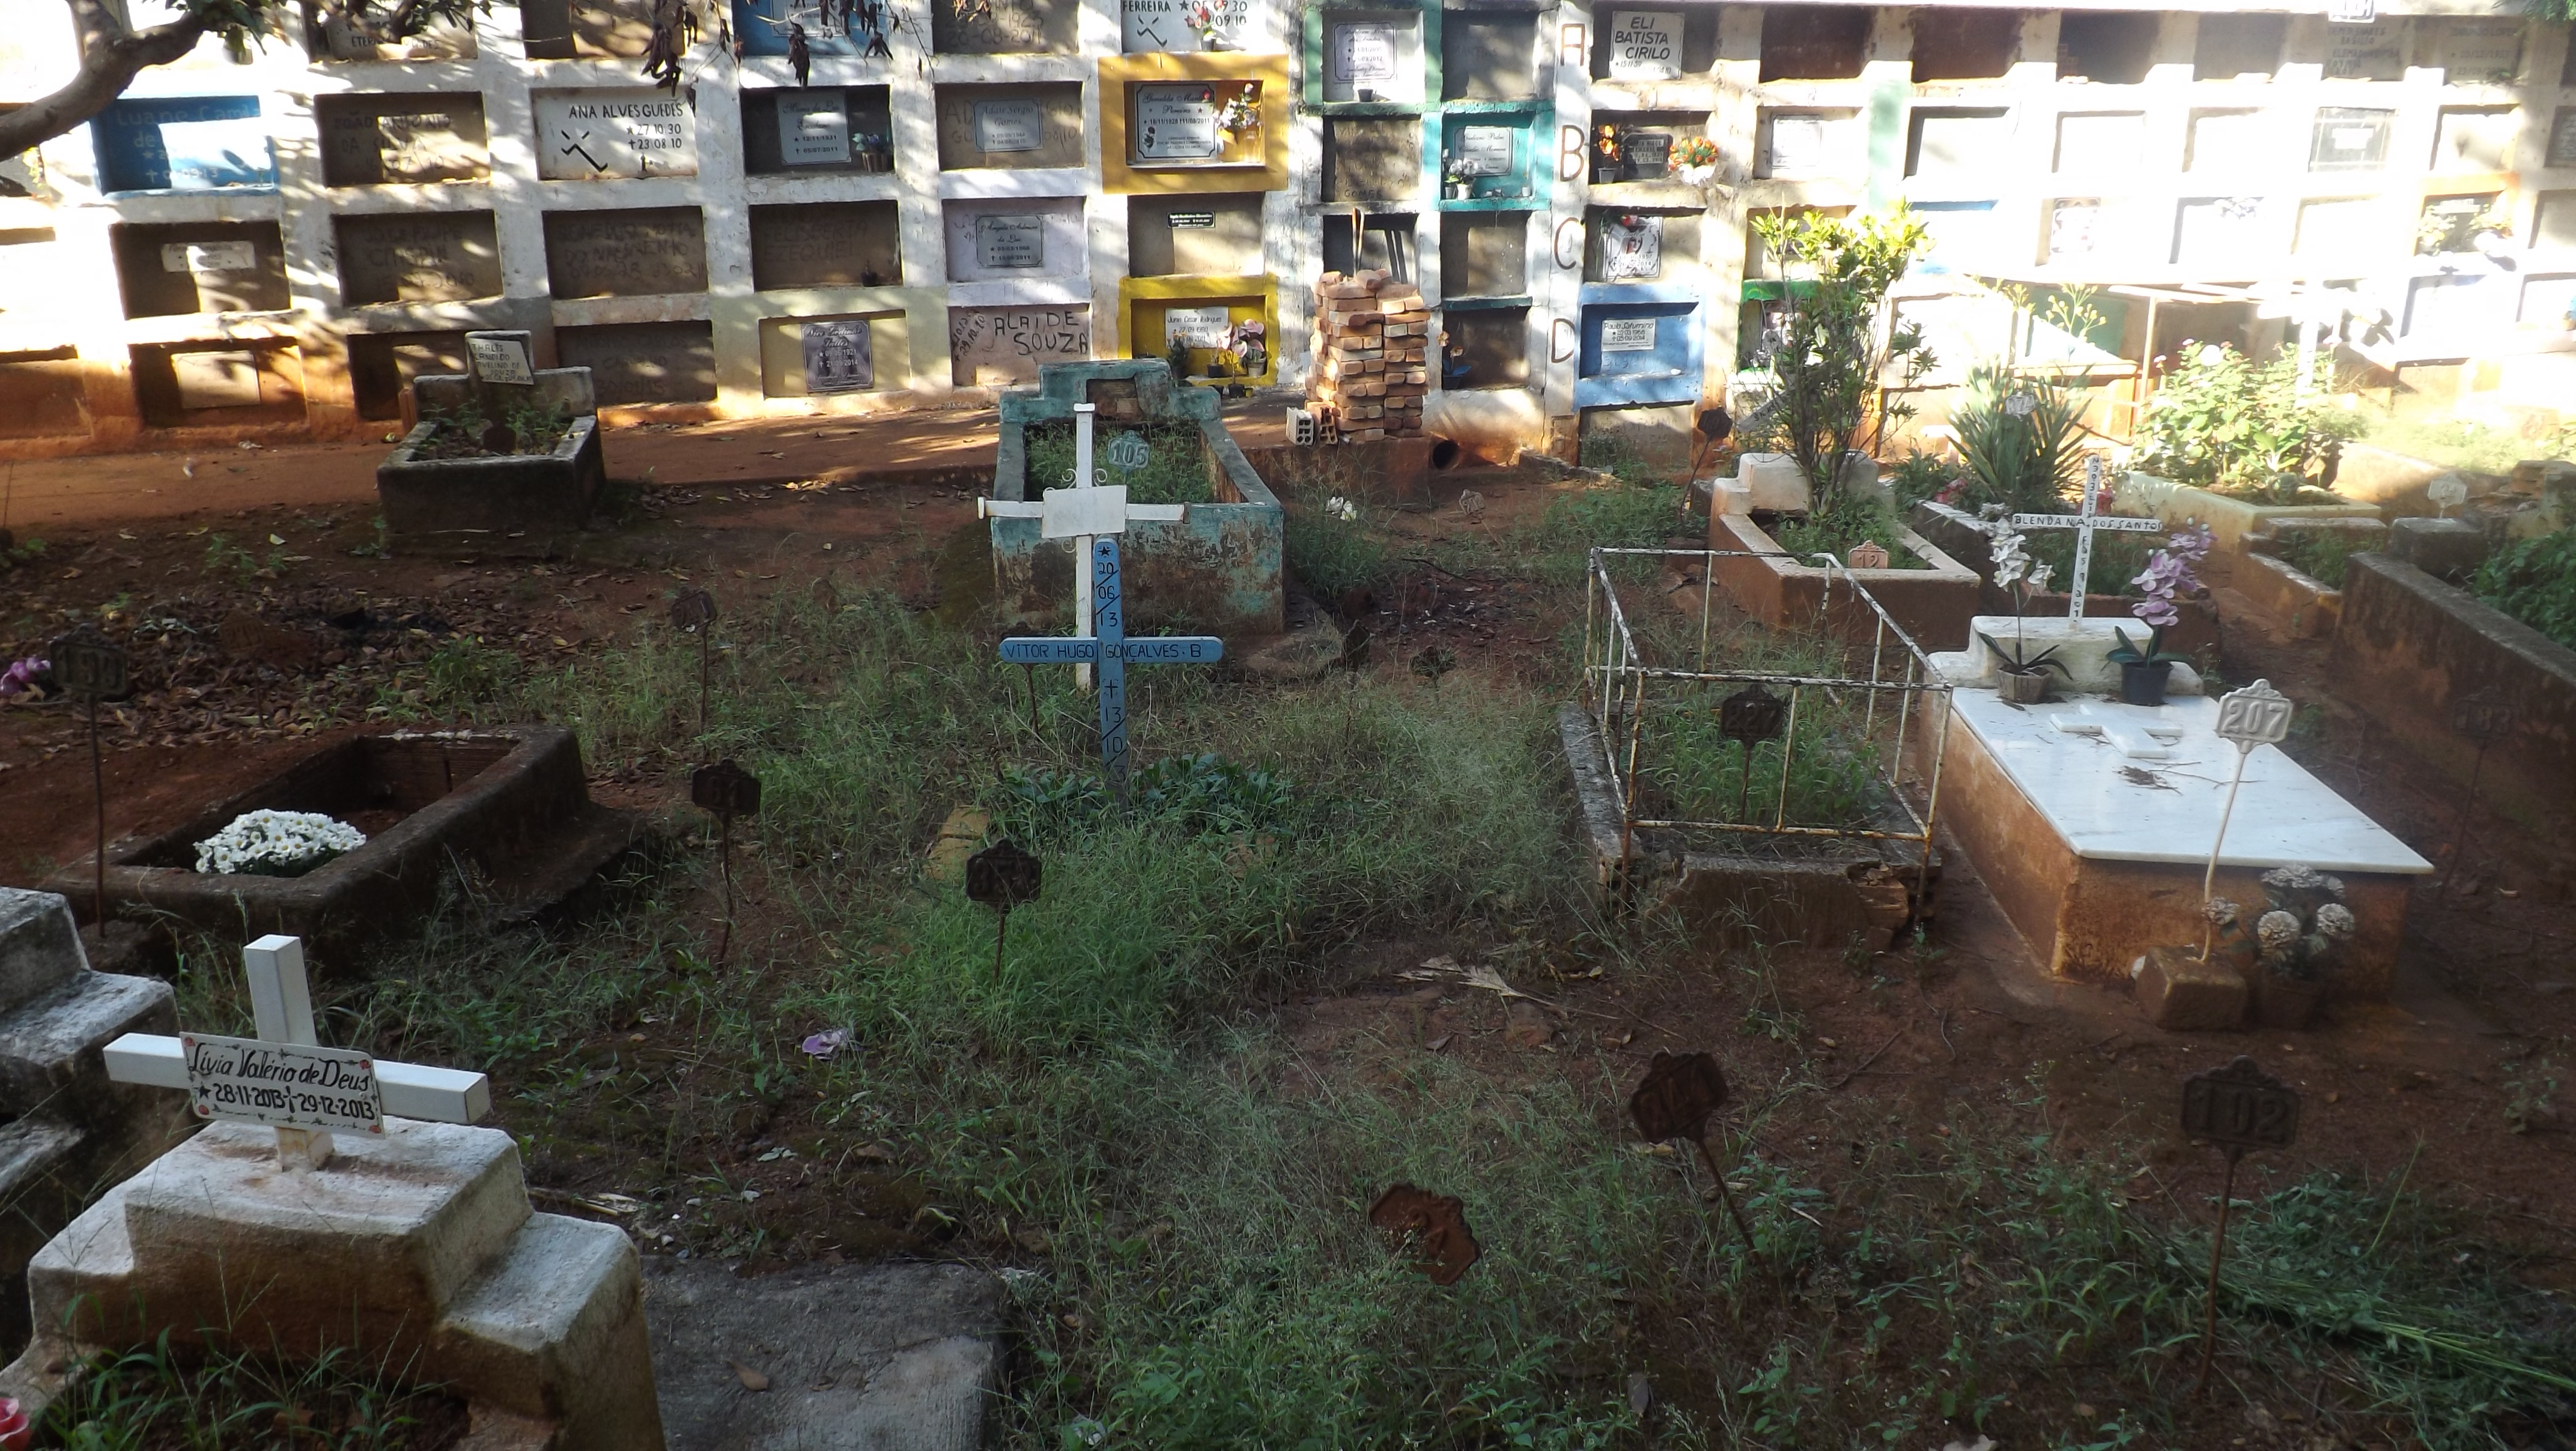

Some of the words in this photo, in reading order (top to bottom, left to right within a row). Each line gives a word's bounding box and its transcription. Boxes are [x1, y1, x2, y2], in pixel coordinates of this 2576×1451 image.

[1123, 1, 1171, 13] FERREIRA
[1630, 17, 1654, 29] ELI
[1561, 23, 1585, 66] A
[1615, 31, 1668, 44] BATISTA
[1625, 47, 1671, 61] CIRILO
[570, 105, 598, 119] ANA
[603, 105, 640, 119] ALVES
[642, 103, 684, 118] GUEDES
[1560, 124, 1585, 181] B
[1554, 217, 1579, 270] C
[472, 343, 503, 353] THALES
[1013, 332, 1089, 356] SOUZA
[1551, 318, 1575, 363] D
[1112, 443, 1148, 467] 105
[2015, 517, 2061, 526] BLENDA
[2118, 521, 2162, 530] SANTOS
[1859, 553, 1879, 568] 12
[1057, 644, 1095, 659] HUGO
[1189, 644, 1201, 658] B
[2222, 700, 2285, 733] 207
[189, 1043, 234, 1076] Lívia
[237, 1048, 297, 1083] Valério
[298, 1062, 320, 1084] de
[318, 1058, 371, 1091] Deus
[2195, 1088, 2288, 1139] 102
